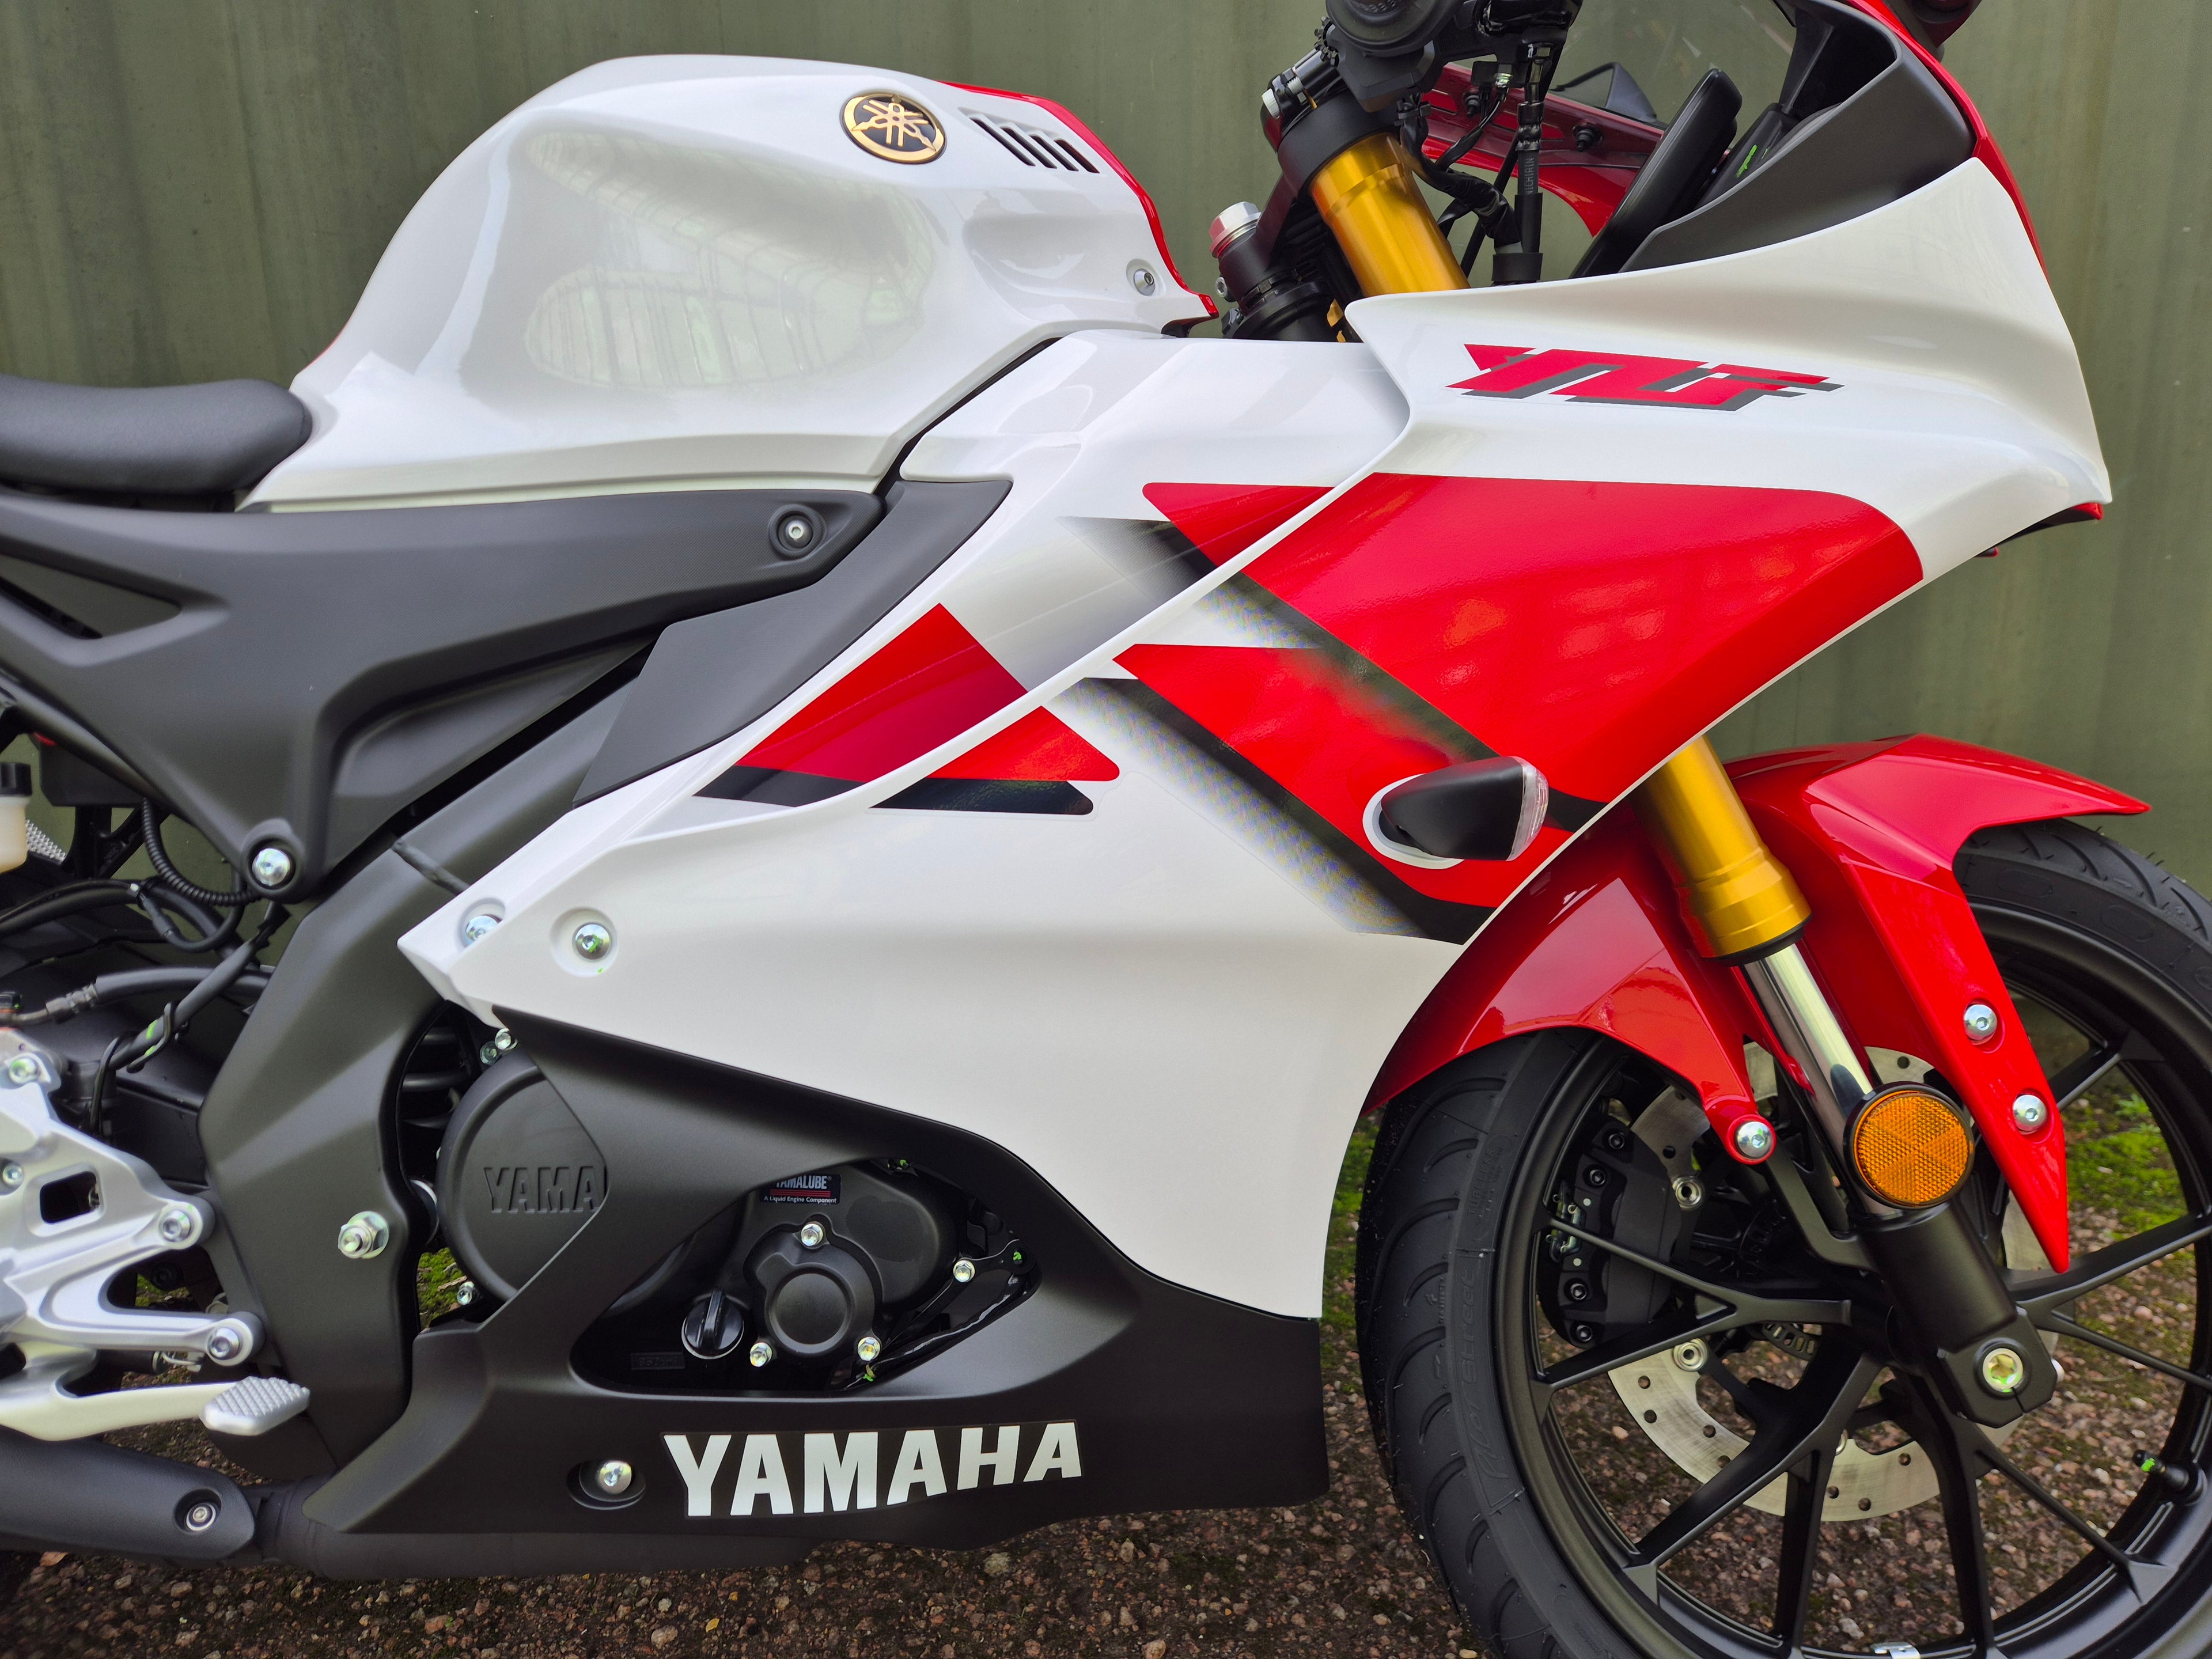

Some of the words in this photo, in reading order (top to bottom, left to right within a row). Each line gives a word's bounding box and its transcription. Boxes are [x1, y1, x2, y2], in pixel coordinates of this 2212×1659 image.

[483, 1165, 608, 1214] YAMA
[805, 1196, 837, 1205] Component
[662, 1422, 1082, 1517] YAMAHA
